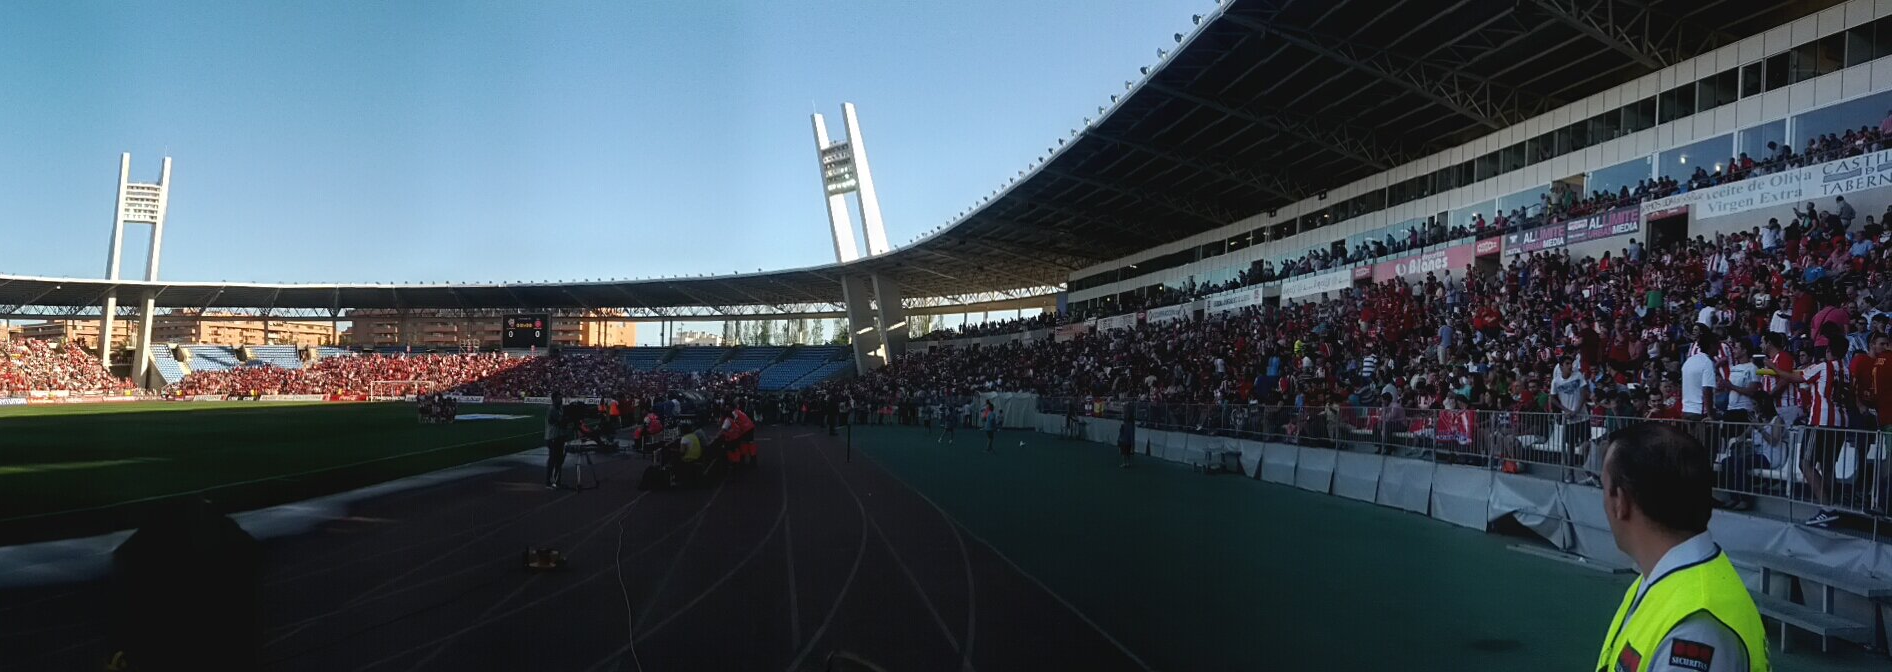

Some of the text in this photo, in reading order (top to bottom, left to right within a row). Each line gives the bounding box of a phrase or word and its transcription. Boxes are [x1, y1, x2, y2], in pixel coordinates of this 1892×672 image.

[1770, 169, 1812, 186] Oliva
[1708, 188, 1803, 213] Virgen Extra
[1408, 256, 1448, 275] Blanes
